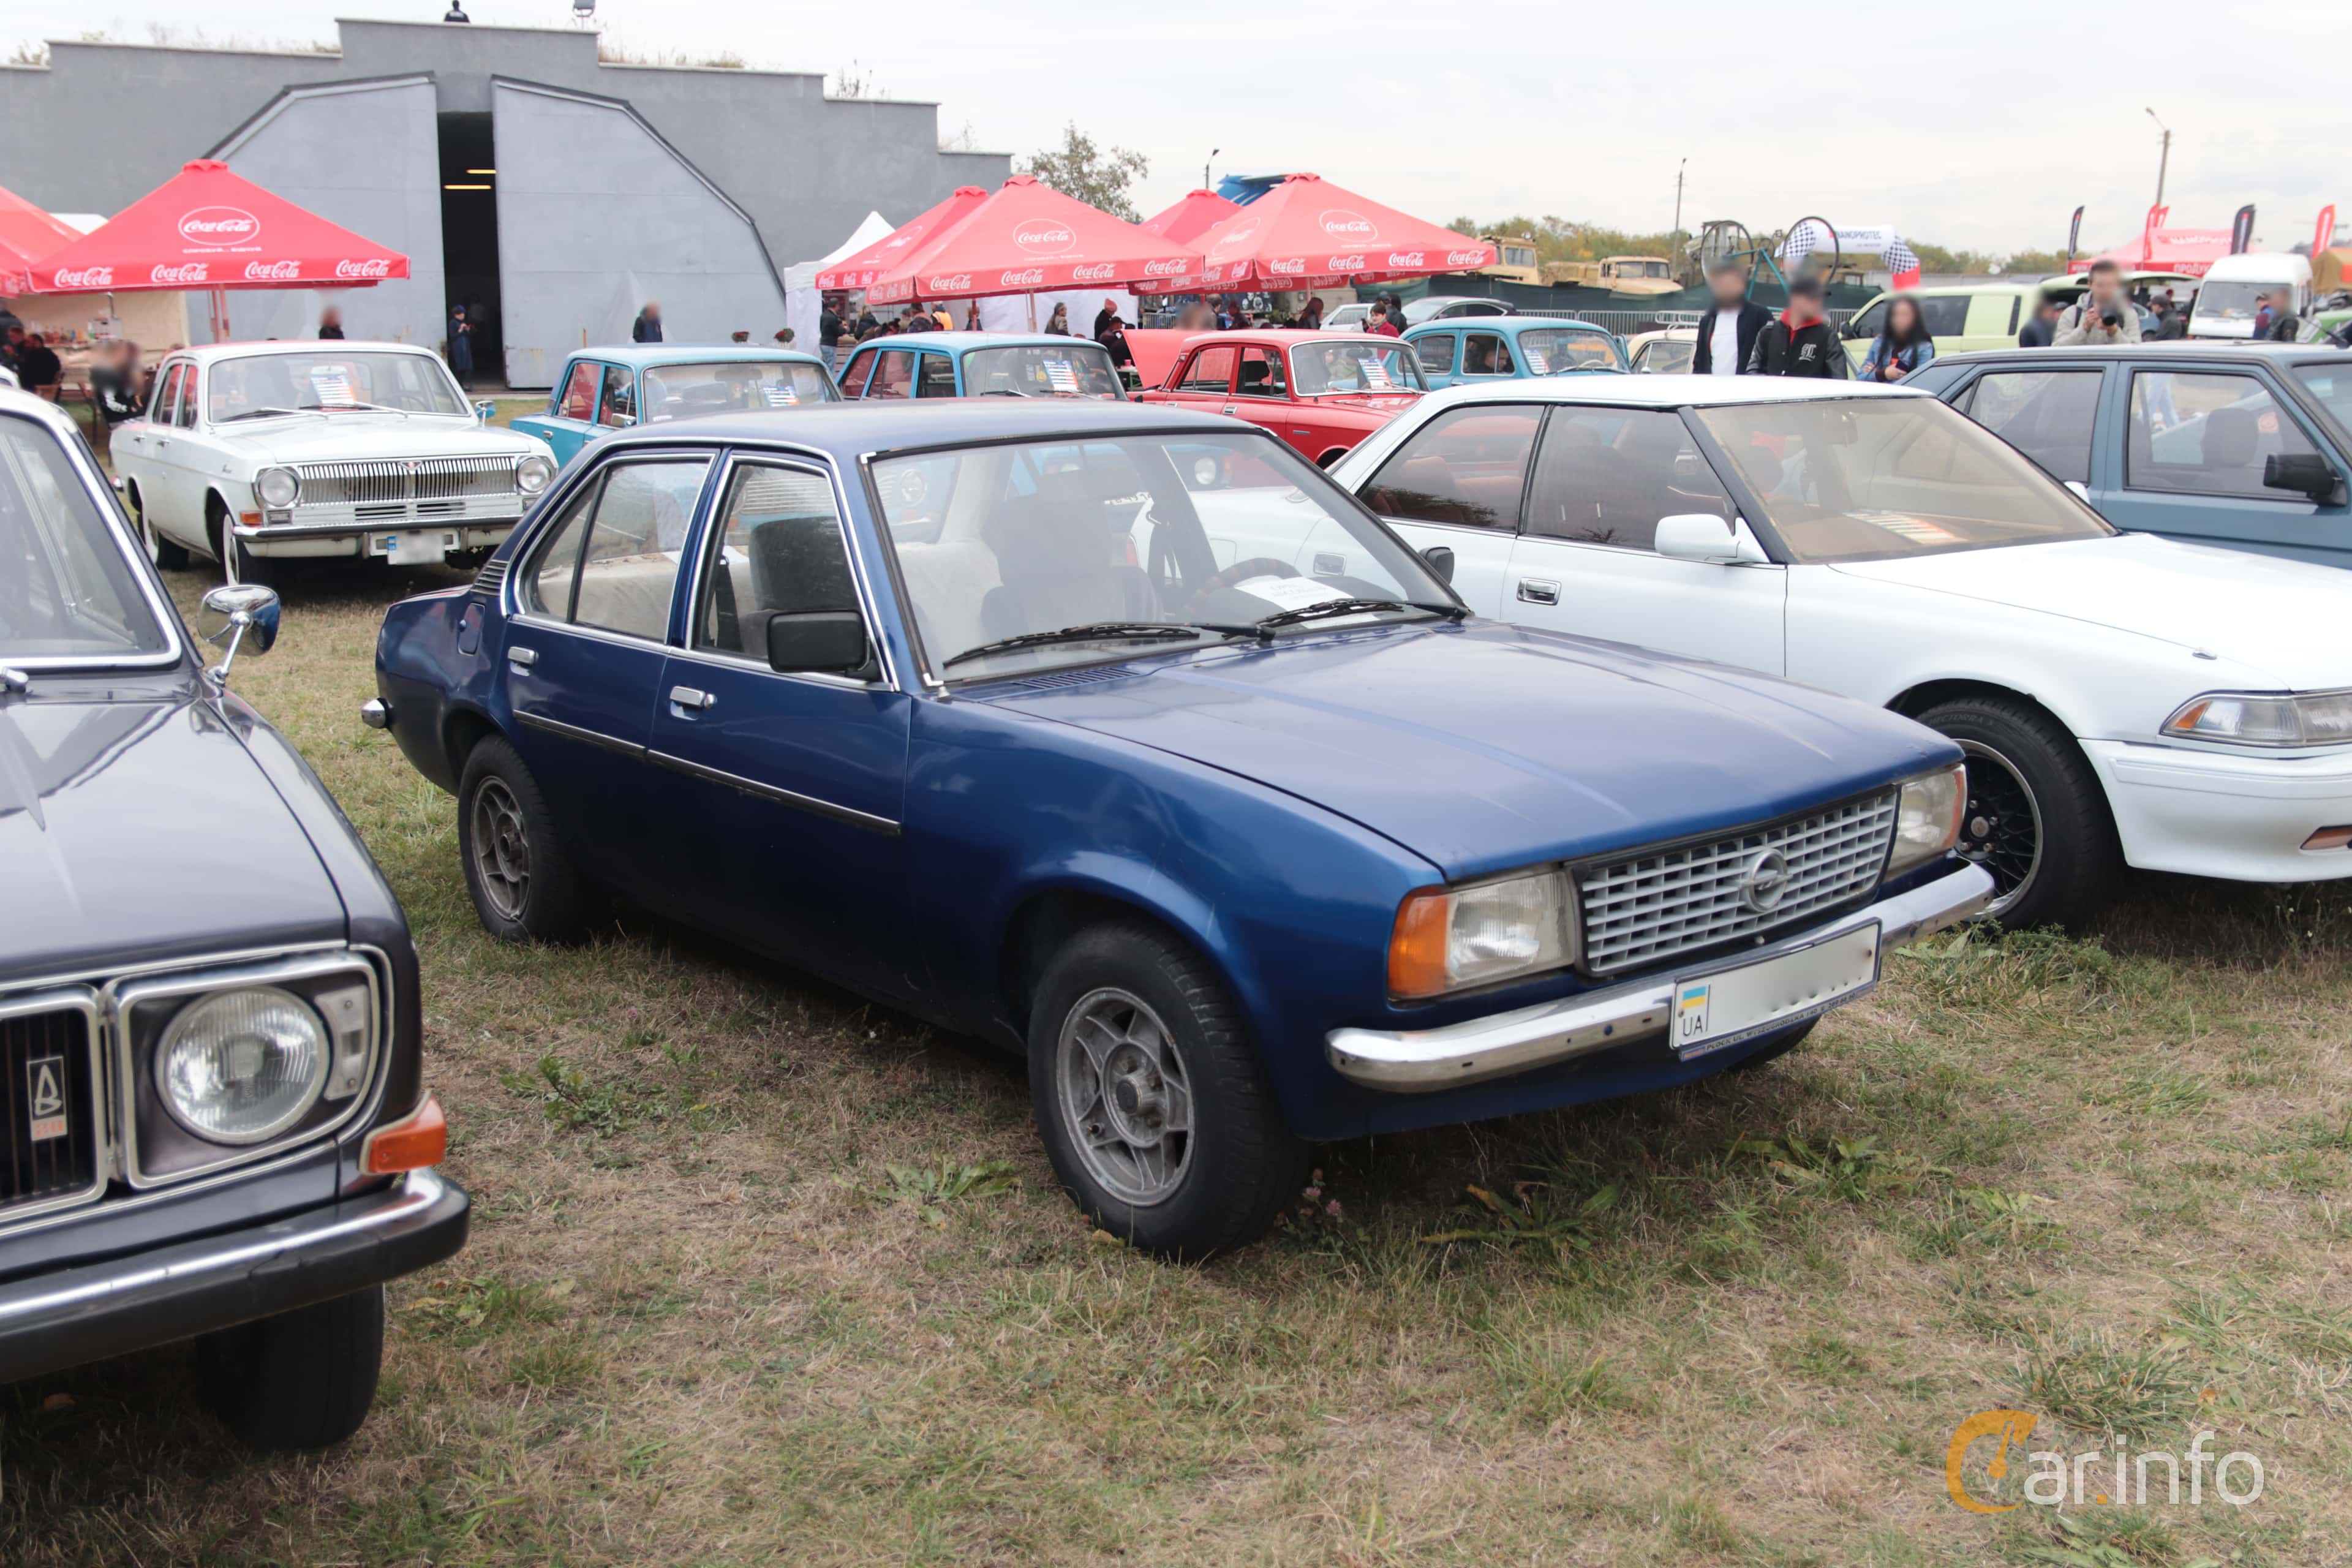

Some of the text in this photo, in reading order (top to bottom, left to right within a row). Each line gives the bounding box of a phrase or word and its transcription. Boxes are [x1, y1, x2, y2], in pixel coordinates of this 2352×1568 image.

[1144, 258, 1188, 275] Coca-Cola
[1270, 258, 1306, 274] Coca-Cola
[1329, 255, 1366, 271] Coca-Cola
[1388, 252, 1425, 267] Coca-Cola
[1447, 250, 1485, 265] Coca-Cola
[151, 263, 209, 283] Coca-Cola
[244, 260, 302, 279] Coca-Cola
[336, 258, 391, 277] Coca-Cola
[1073, 263, 1117, 281] Coca-Cola
[54, 266, 114, 288] Coca-Cola
[930, 274, 973, 292] Coca-Cola
[1001, 268, 1044, 286] Coca-Cola
[1683, 1014, 1703, 1036] UA
